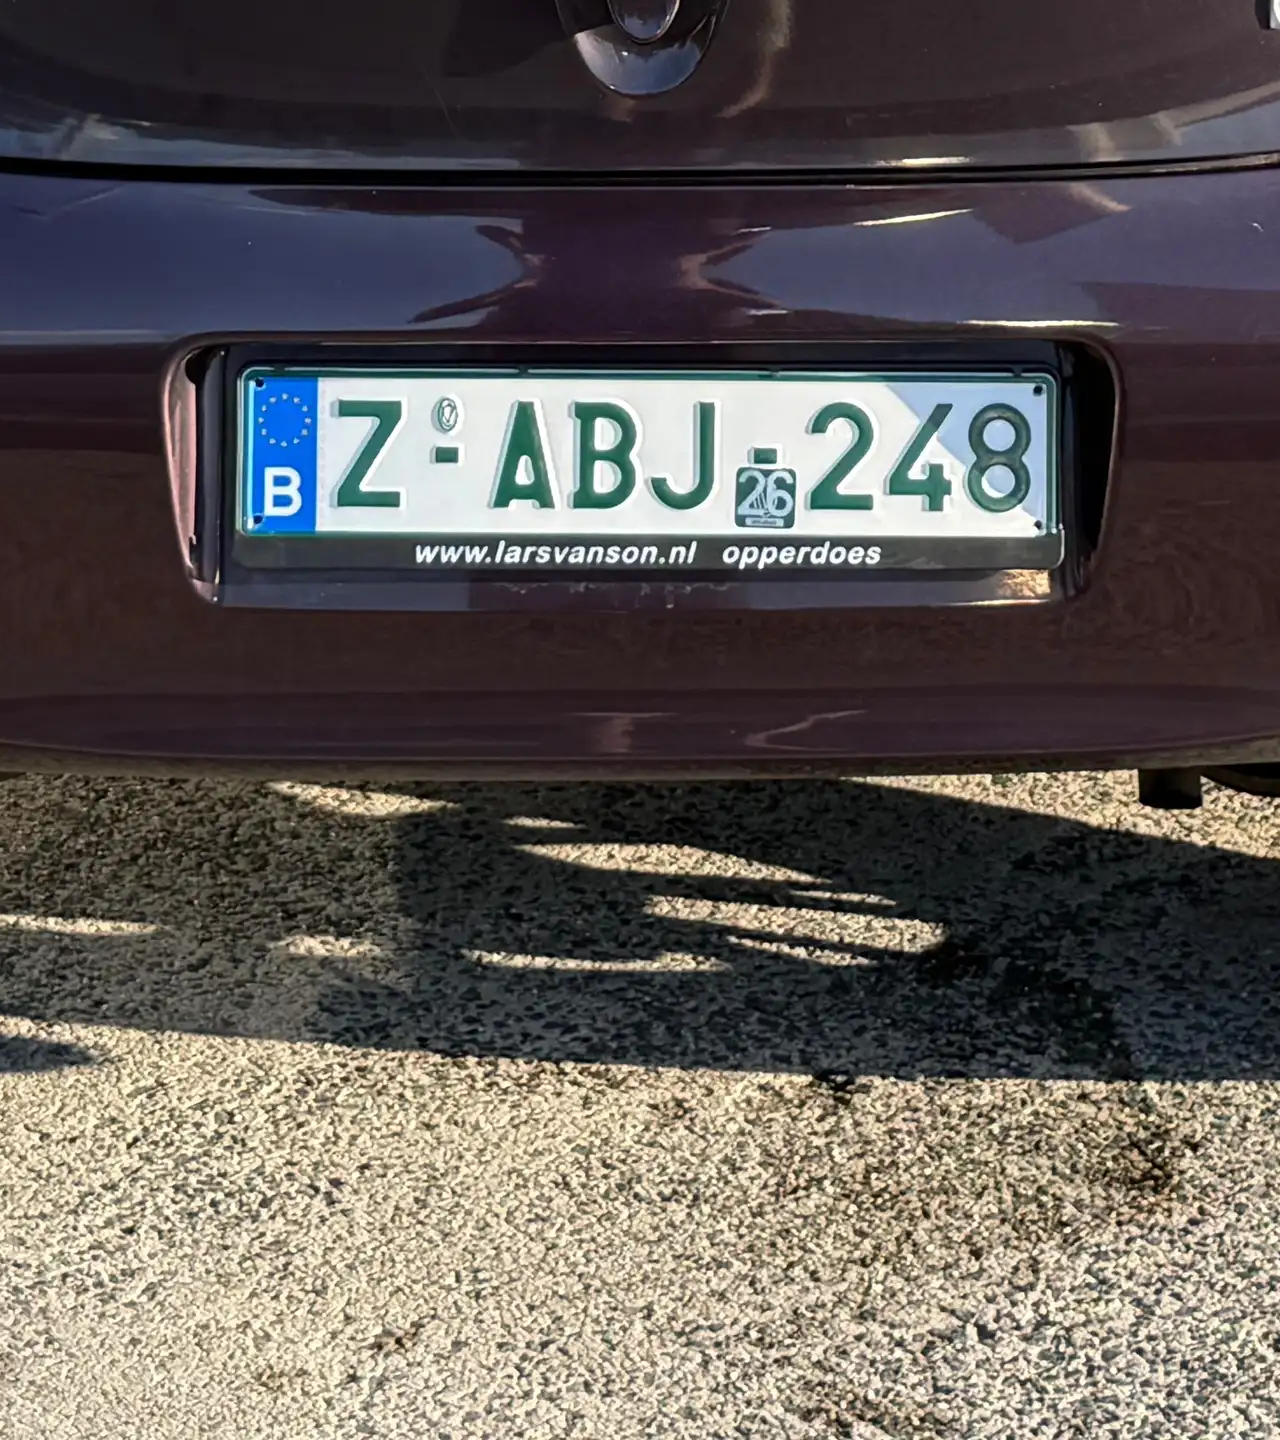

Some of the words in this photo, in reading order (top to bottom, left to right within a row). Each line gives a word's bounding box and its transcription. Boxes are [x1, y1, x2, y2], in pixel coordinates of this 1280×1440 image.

[263, 465, 303, 517] B
[736, 468, 795, 518] 26
[414, 540, 698, 565] www.larsvanson.nl
[721, 540, 882, 571] opperdoes
